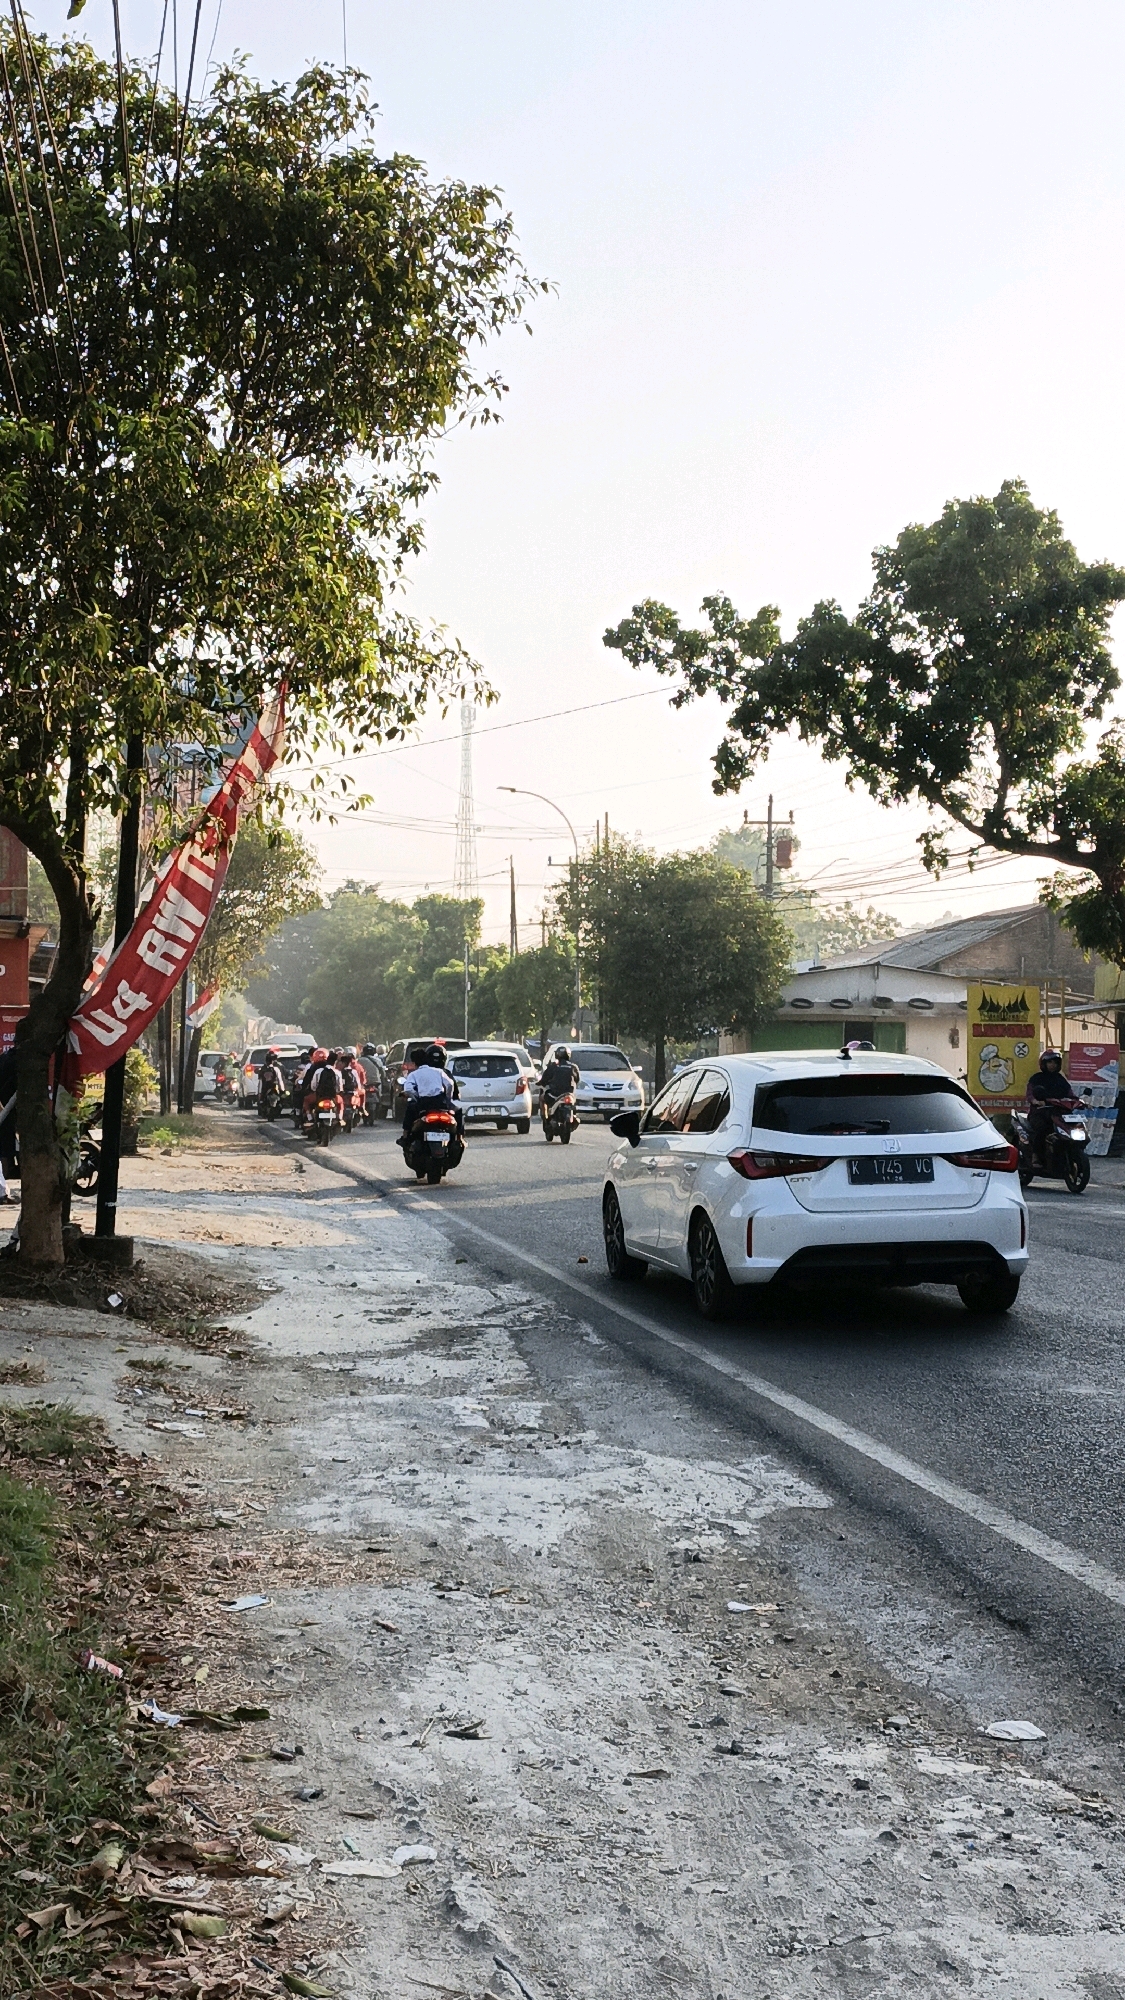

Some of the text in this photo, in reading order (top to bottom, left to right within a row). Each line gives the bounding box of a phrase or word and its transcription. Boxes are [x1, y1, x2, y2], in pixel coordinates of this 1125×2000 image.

[136, 882, 207, 977] RW
[852, 1158, 932, 1175] K 1745 VC
